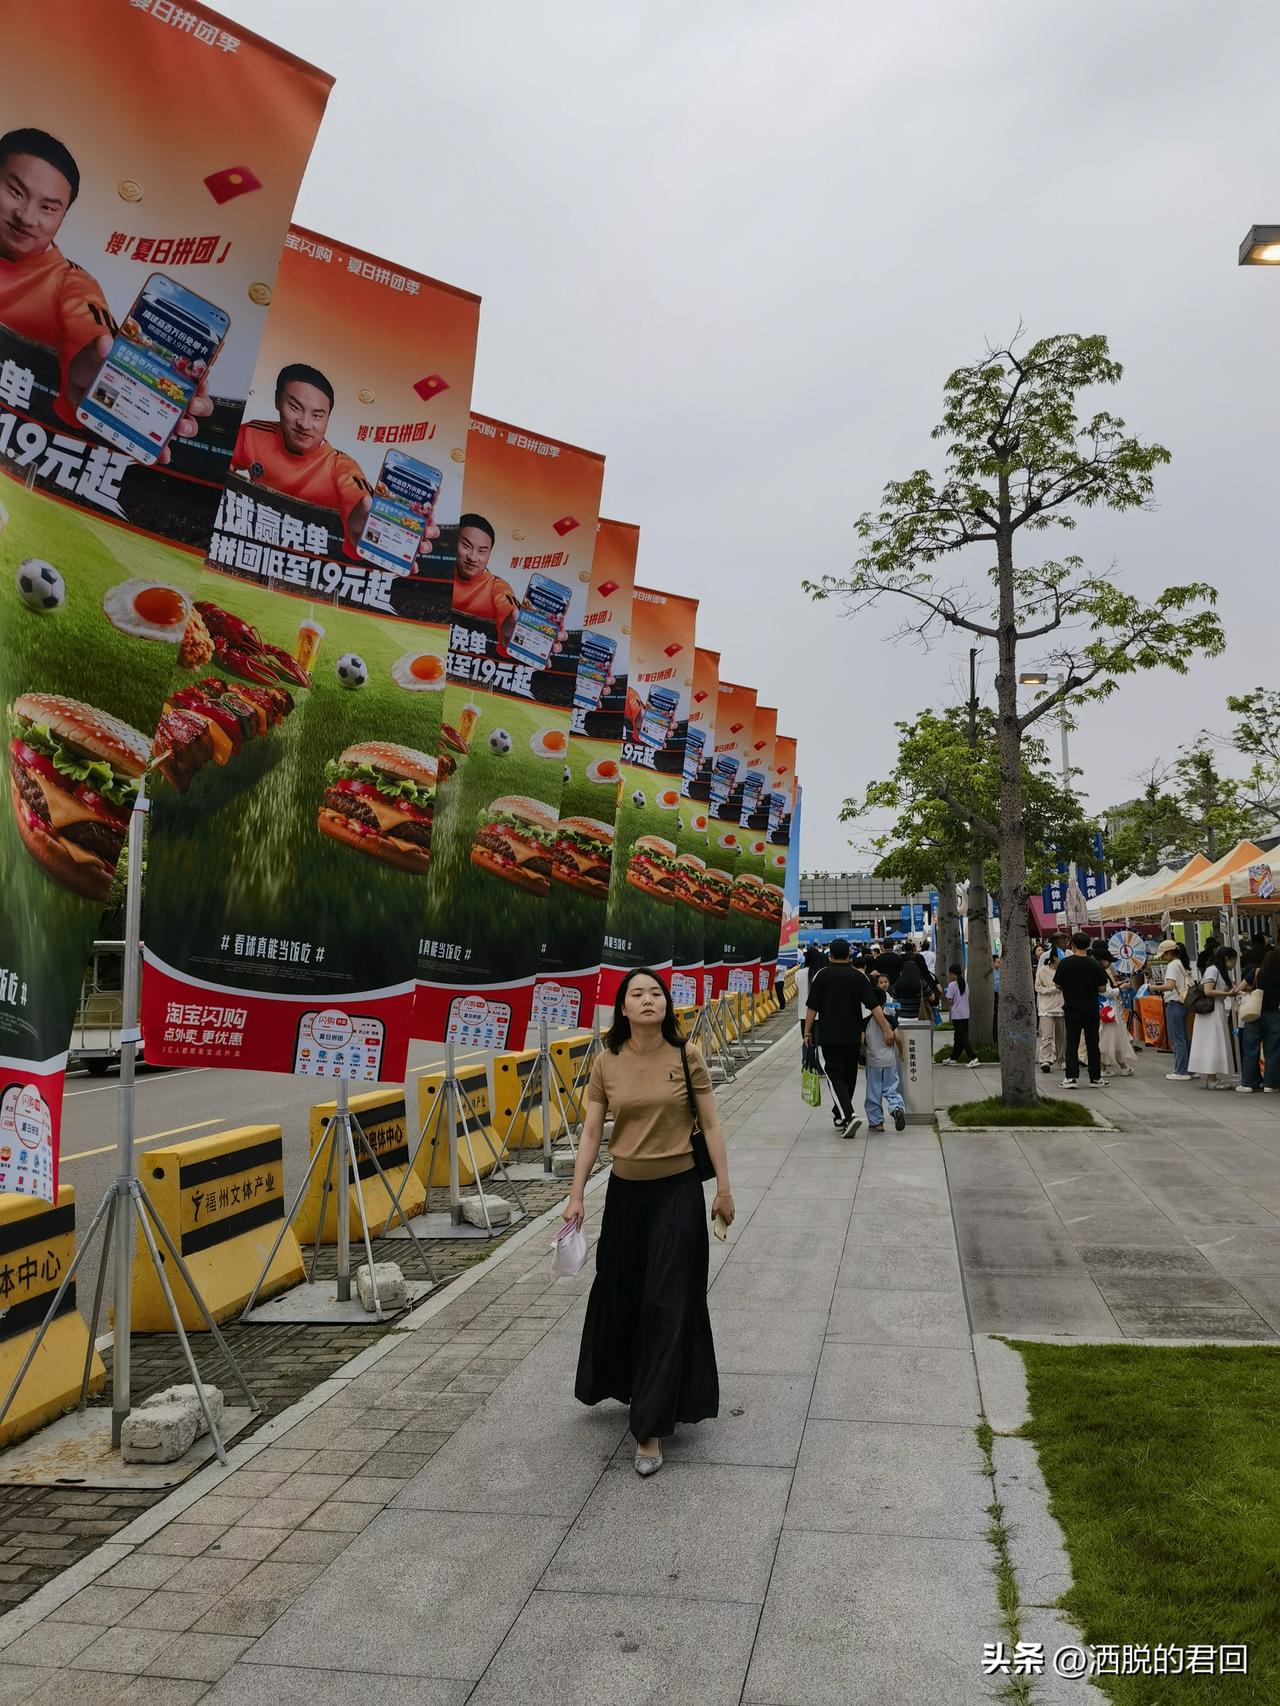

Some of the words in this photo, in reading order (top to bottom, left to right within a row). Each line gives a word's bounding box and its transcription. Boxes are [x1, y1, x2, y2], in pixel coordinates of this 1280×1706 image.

[105, 231, 232, 265] 搜「夏日拼团」
[357, 421, 437, 443] 搜「夏日拼团」
[449, 623, 487, 655] 免单
[165, 1002, 248, 1029] 淘宝闪购
[205, 1172, 275, 1215] 福州文体产业
